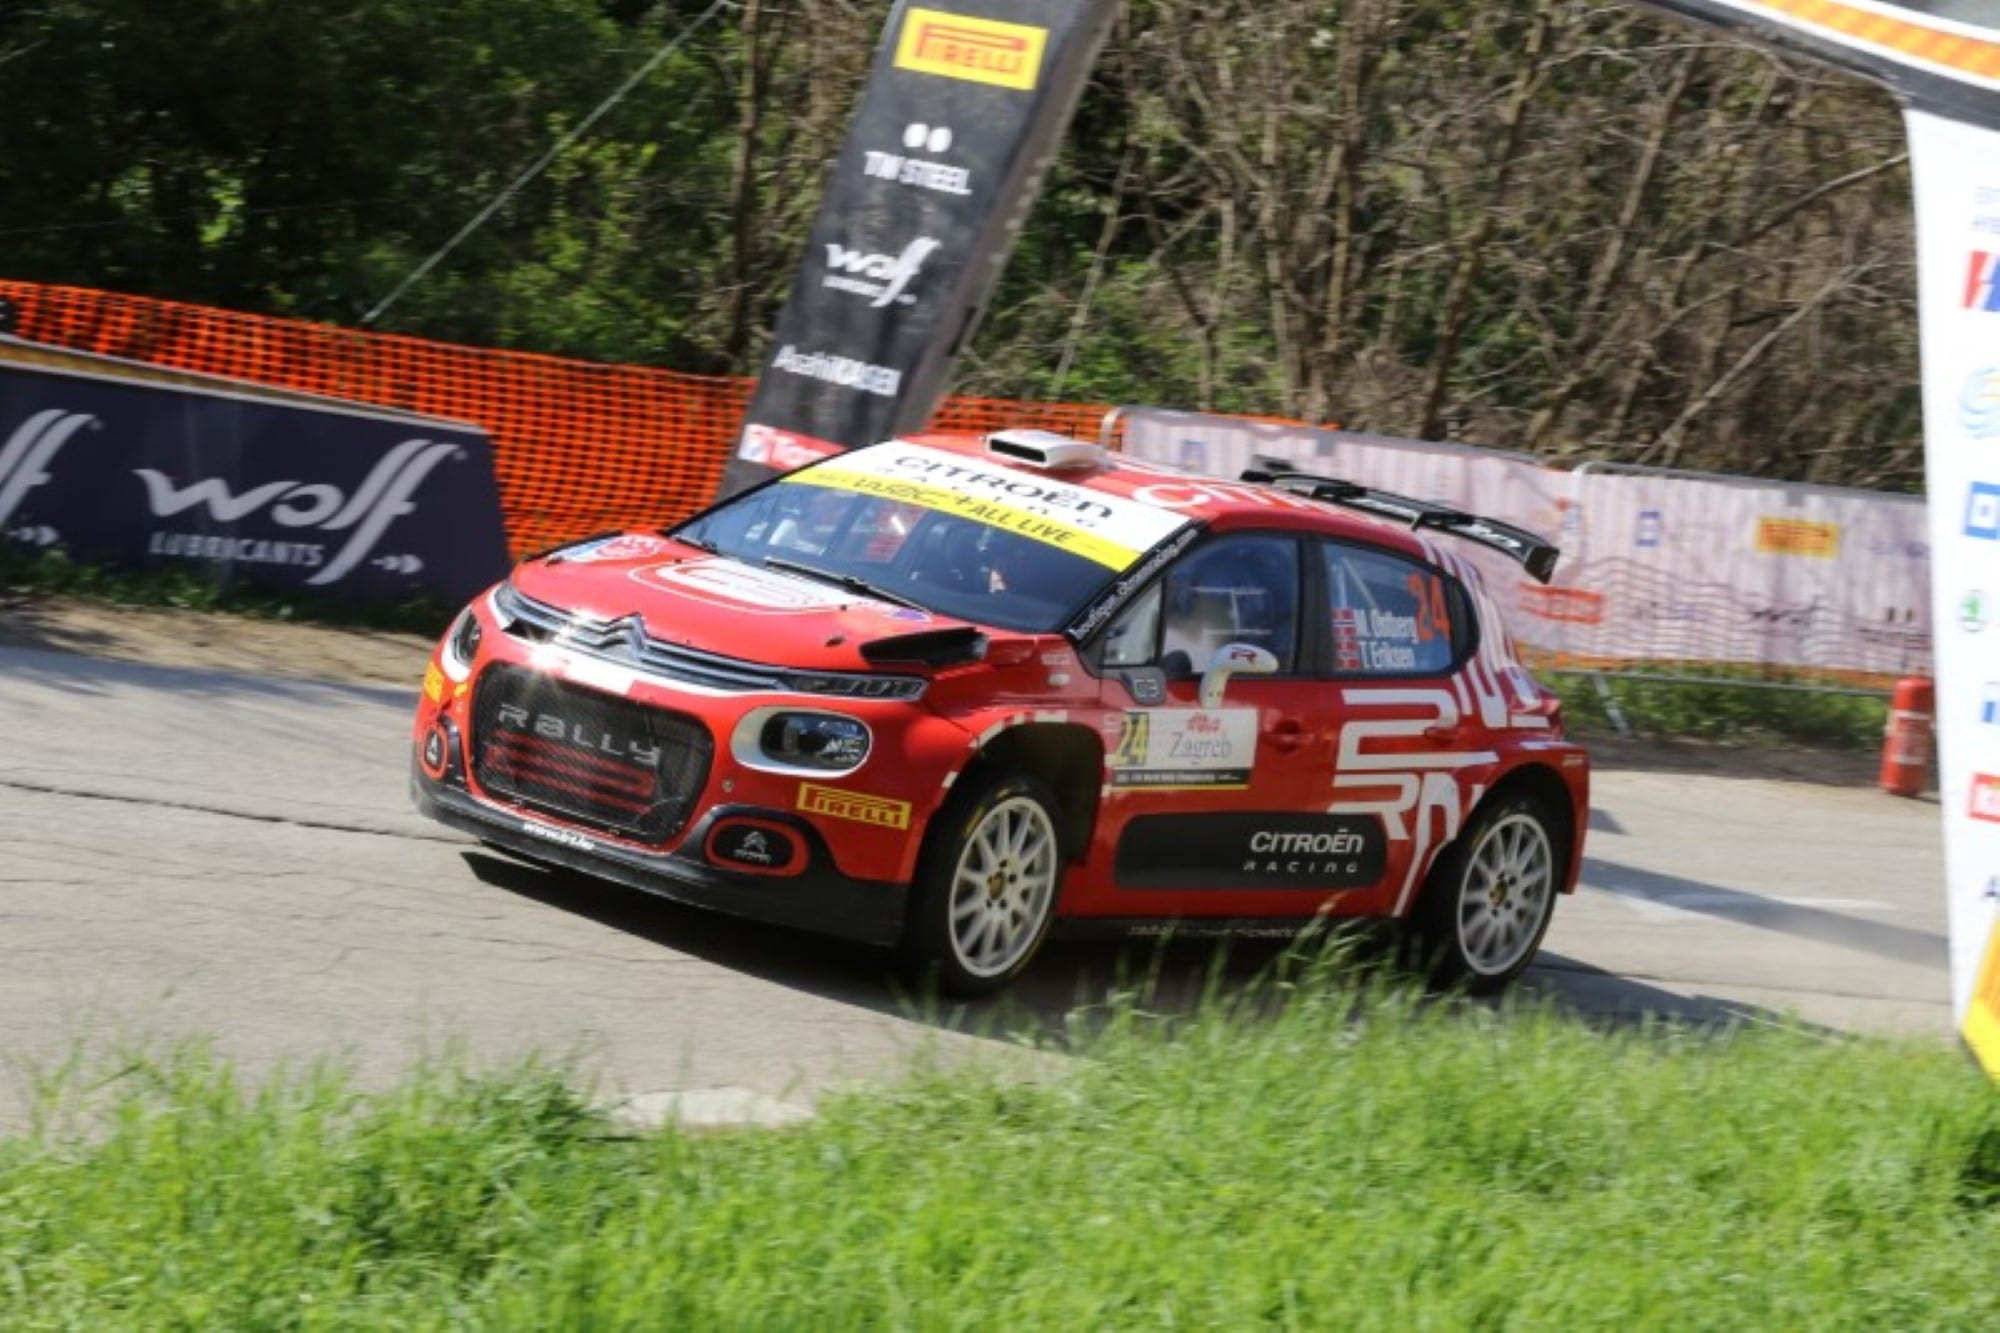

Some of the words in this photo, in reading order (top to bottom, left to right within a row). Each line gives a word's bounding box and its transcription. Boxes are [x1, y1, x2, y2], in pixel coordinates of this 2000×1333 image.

[916, 23, 1027, 74] PIRELLI
[899, 159, 973, 195] STEEL
[966, 504, 1021, 526] ALL
[1017, 518, 1075, 543] LIVE
[149, 531, 326, 566] LUBRICANTS
[1406, 570, 1452, 641] 24
[498, 703, 662, 767] RALLY
[1110, 712, 1149, 766] 24
[1168, 731, 1232, 761] Zagreb
[802, 785, 908, 828] PIRELLI
